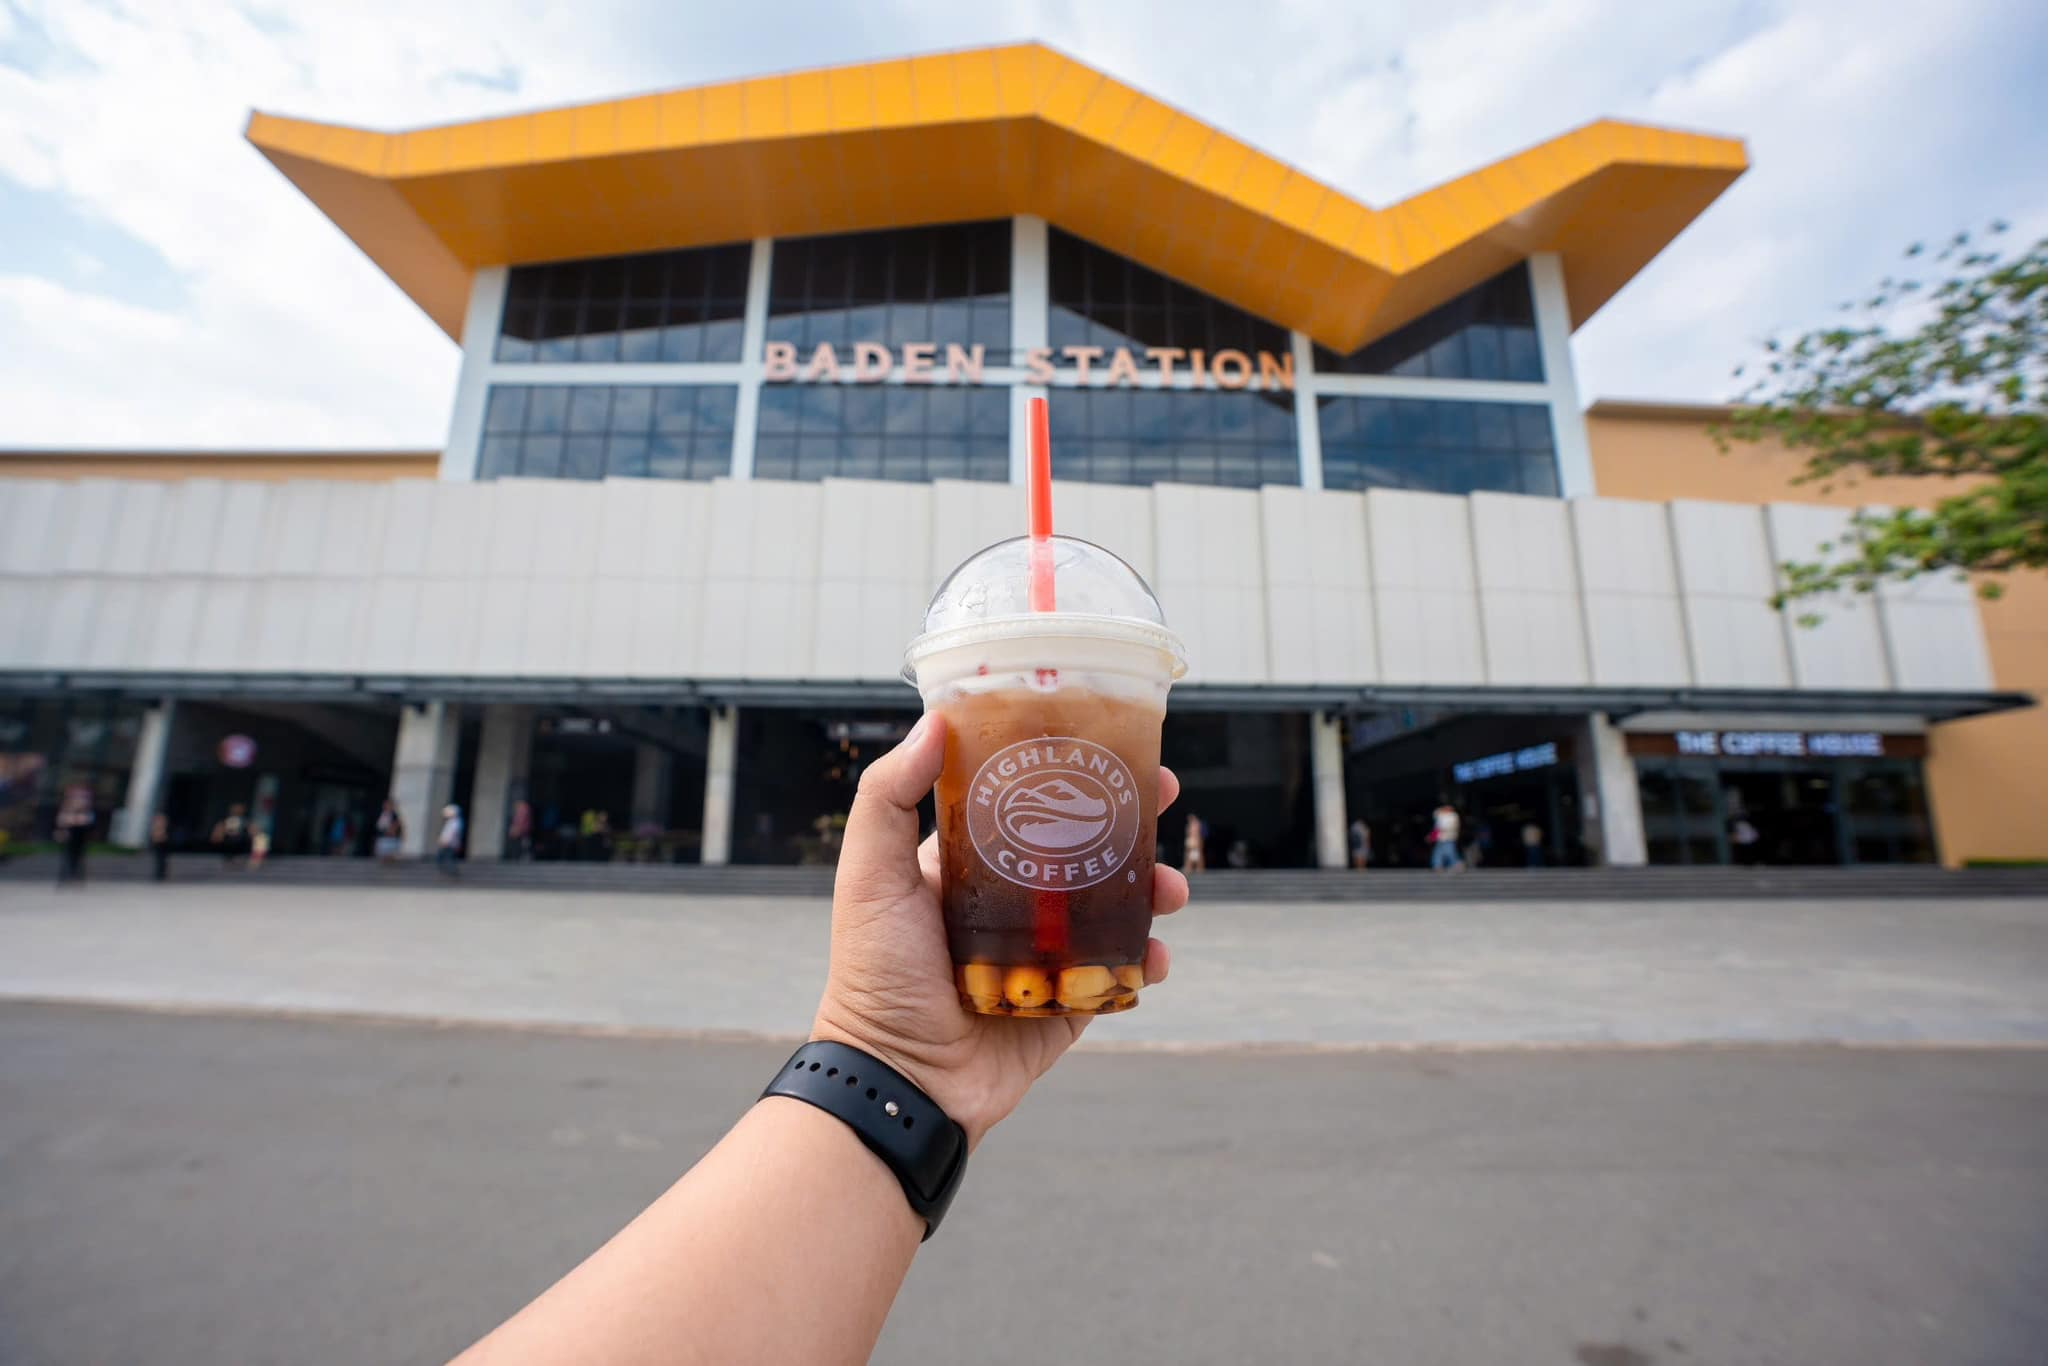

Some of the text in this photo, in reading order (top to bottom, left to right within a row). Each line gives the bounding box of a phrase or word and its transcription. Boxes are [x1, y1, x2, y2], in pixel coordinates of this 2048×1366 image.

[766, 341, 1295, 391] BADEN STATION
[1676, 731, 1719, 755] THE
[1721, 732, 1805, 756] COFFEE
[976, 746, 1132, 807] HIGHLANDS
[997, 846, 1119, 882] COFFEE
